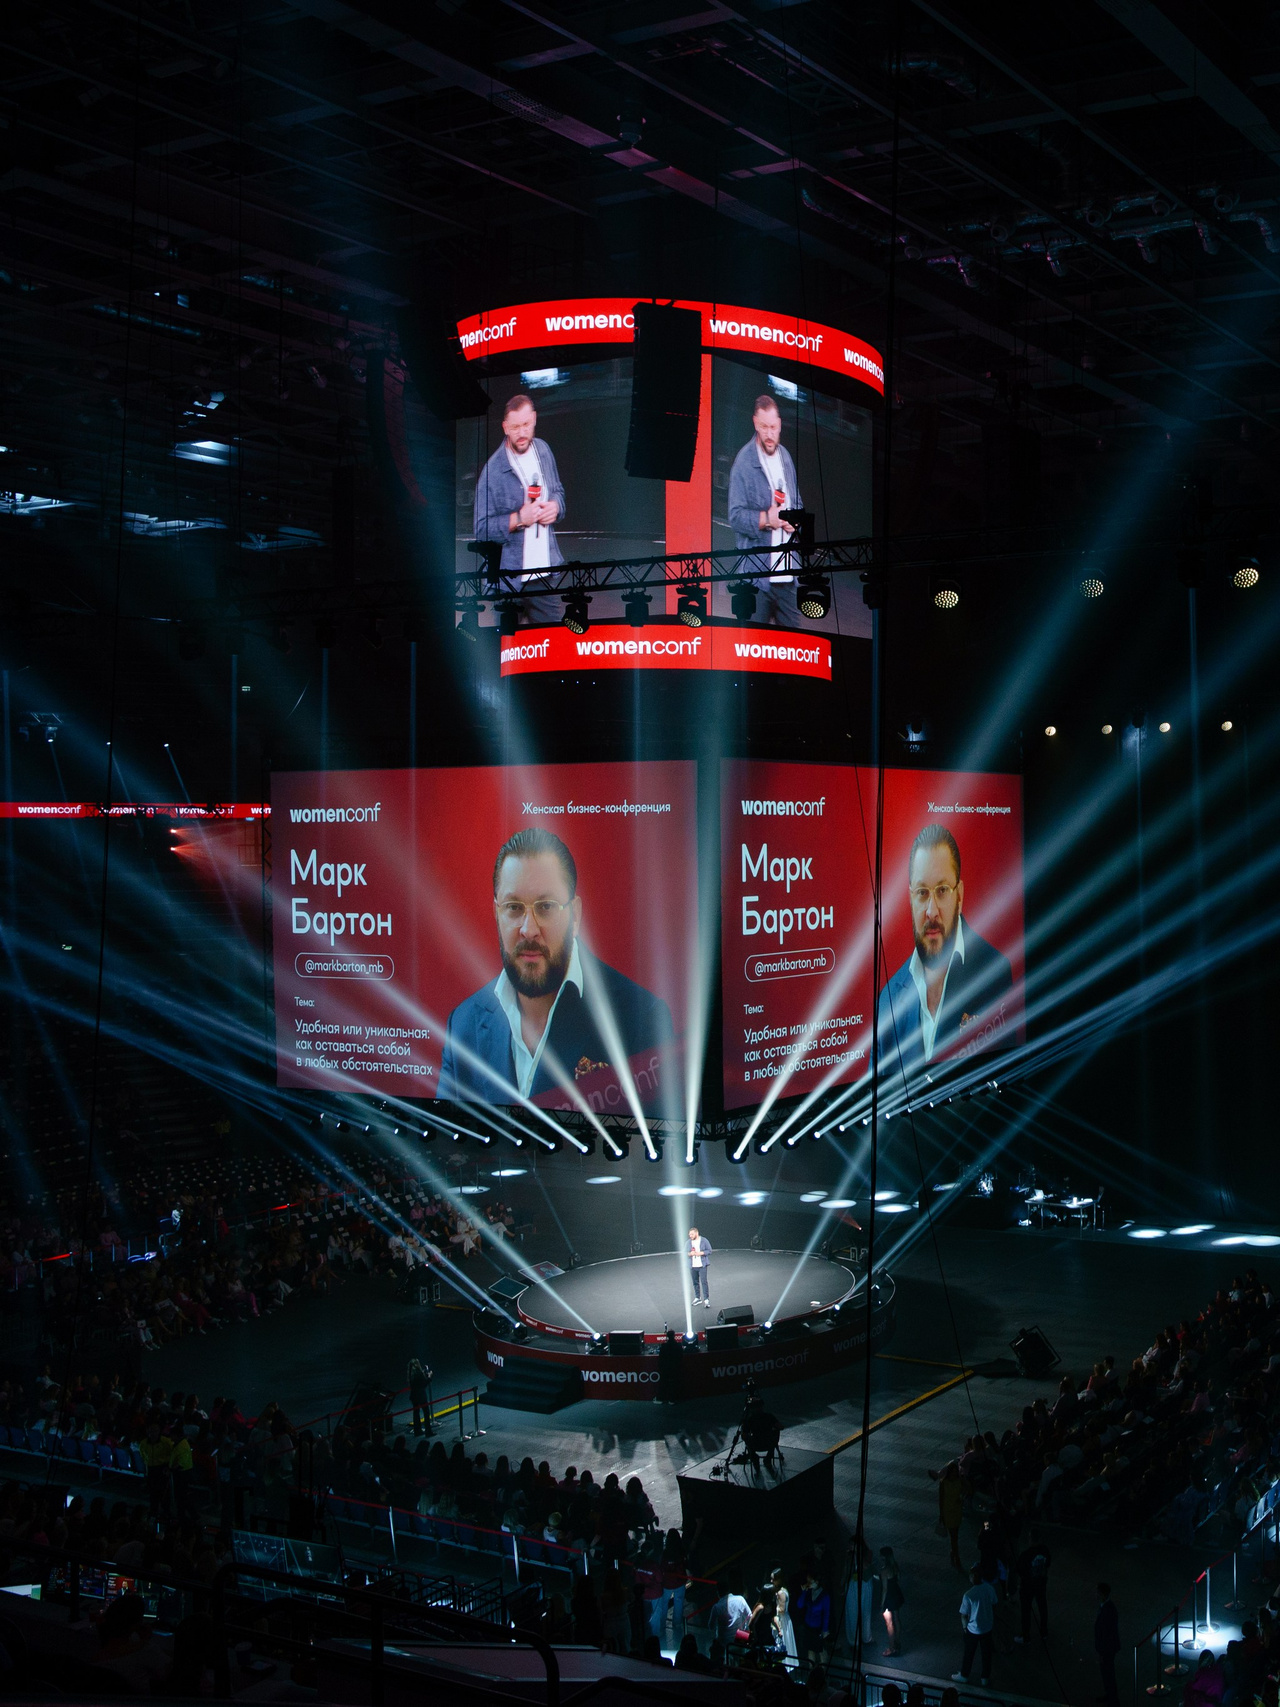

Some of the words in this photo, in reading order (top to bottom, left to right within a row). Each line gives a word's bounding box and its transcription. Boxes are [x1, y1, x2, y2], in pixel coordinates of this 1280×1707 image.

[709, 319, 823, 353] womenconf
[576, 637, 702, 656] womenconf
[735, 642, 820, 664] womenconf
[18, 805, 81, 815] womenconf
[290, 802, 381, 823] womenconf
[522, 802, 564, 815] Женская
[567, 799, 671, 817] бизнес-конференция
[741, 797, 825, 816] womenconf
[927, 802, 954, 813] Женская
[290, 849, 367, 897] Марк
[741, 843, 813, 893] Марк
[291, 897, 392, 946] Бартон
[742, 896, 834, 944] Бартон
[305, 959, 384, 974] @markbarton_mb
[754, 956, 827, 977] @markbarton_mb
[294, 996, 315, 1007] Тема:
[744, 1004, 764, 1015] Тема:
[295, 1019, 340, 1034] Удобная
[343, 1025, 362, 1035] или
[365, 1026, 430, 1039] уникальная:
[744, 1025, 787, 1044] Удобная
[790, 1023, 807, 1036] или
[810, 1014, 863, 1036] уникальная:
[295, 1040, 312, 1050] как
[315, 1041, 375, 1053] оставаться
[377, 1041, 411, 1056] собой
[744, 1049, 761, 1062] как
[764, 1039, 818, 1059] оставаться
[820, 1031, 848, 1048] собой
[296, 1058, 302, 1066] в
[305, 1055, 339, 1069] любых
[342, 1057, 433, 1075] обстоятельствах
[744, 1071, 750, 1081] в
[752, 1062, 786, 1080] любых
[788, 1049, 865, 1073] обстоятельствах
[712, 1350, 809, 1378] womenconf
[833, 1317, 887, 1353] womeconf
